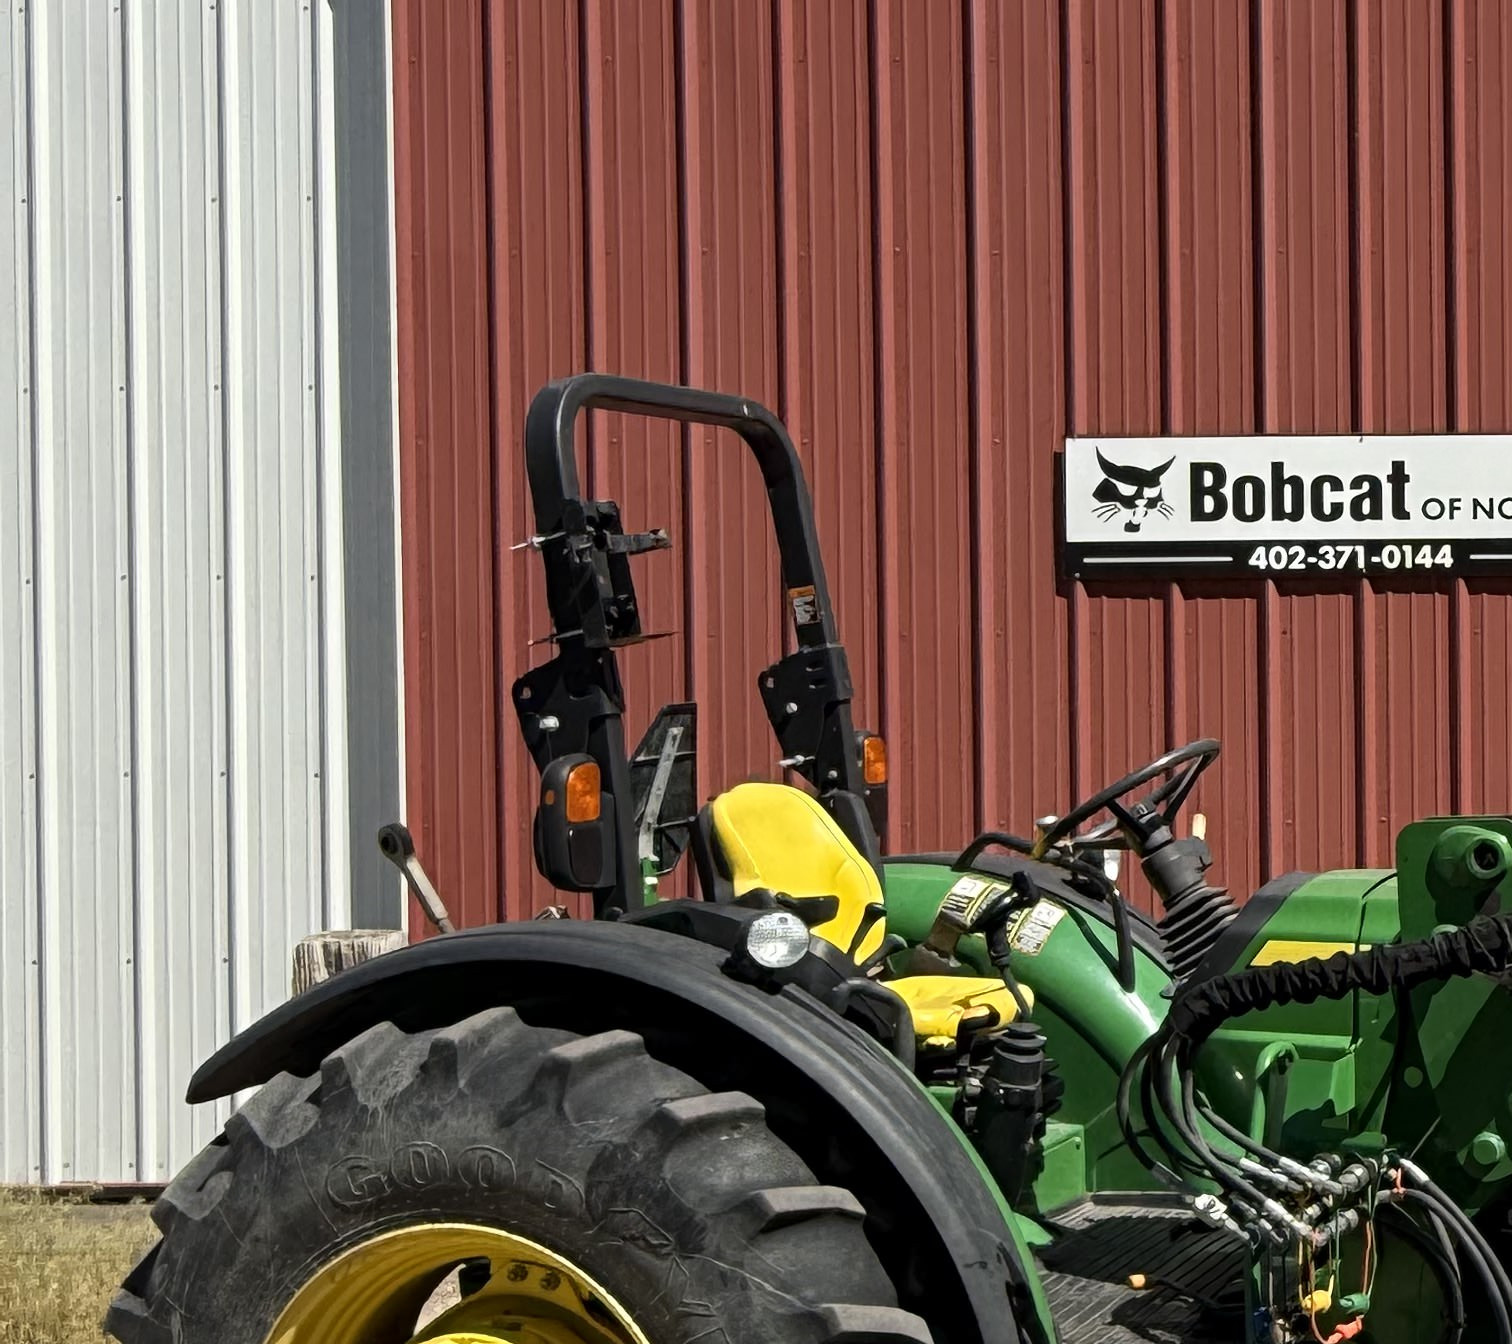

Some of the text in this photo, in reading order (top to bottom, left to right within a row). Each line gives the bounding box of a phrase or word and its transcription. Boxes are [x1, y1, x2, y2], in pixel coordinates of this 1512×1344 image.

[1190, 460, 1411, 523] Bobcat
[1421, 497, 1462, 521] OF
[1248, 544, 1455, 571] 402-371-0144
